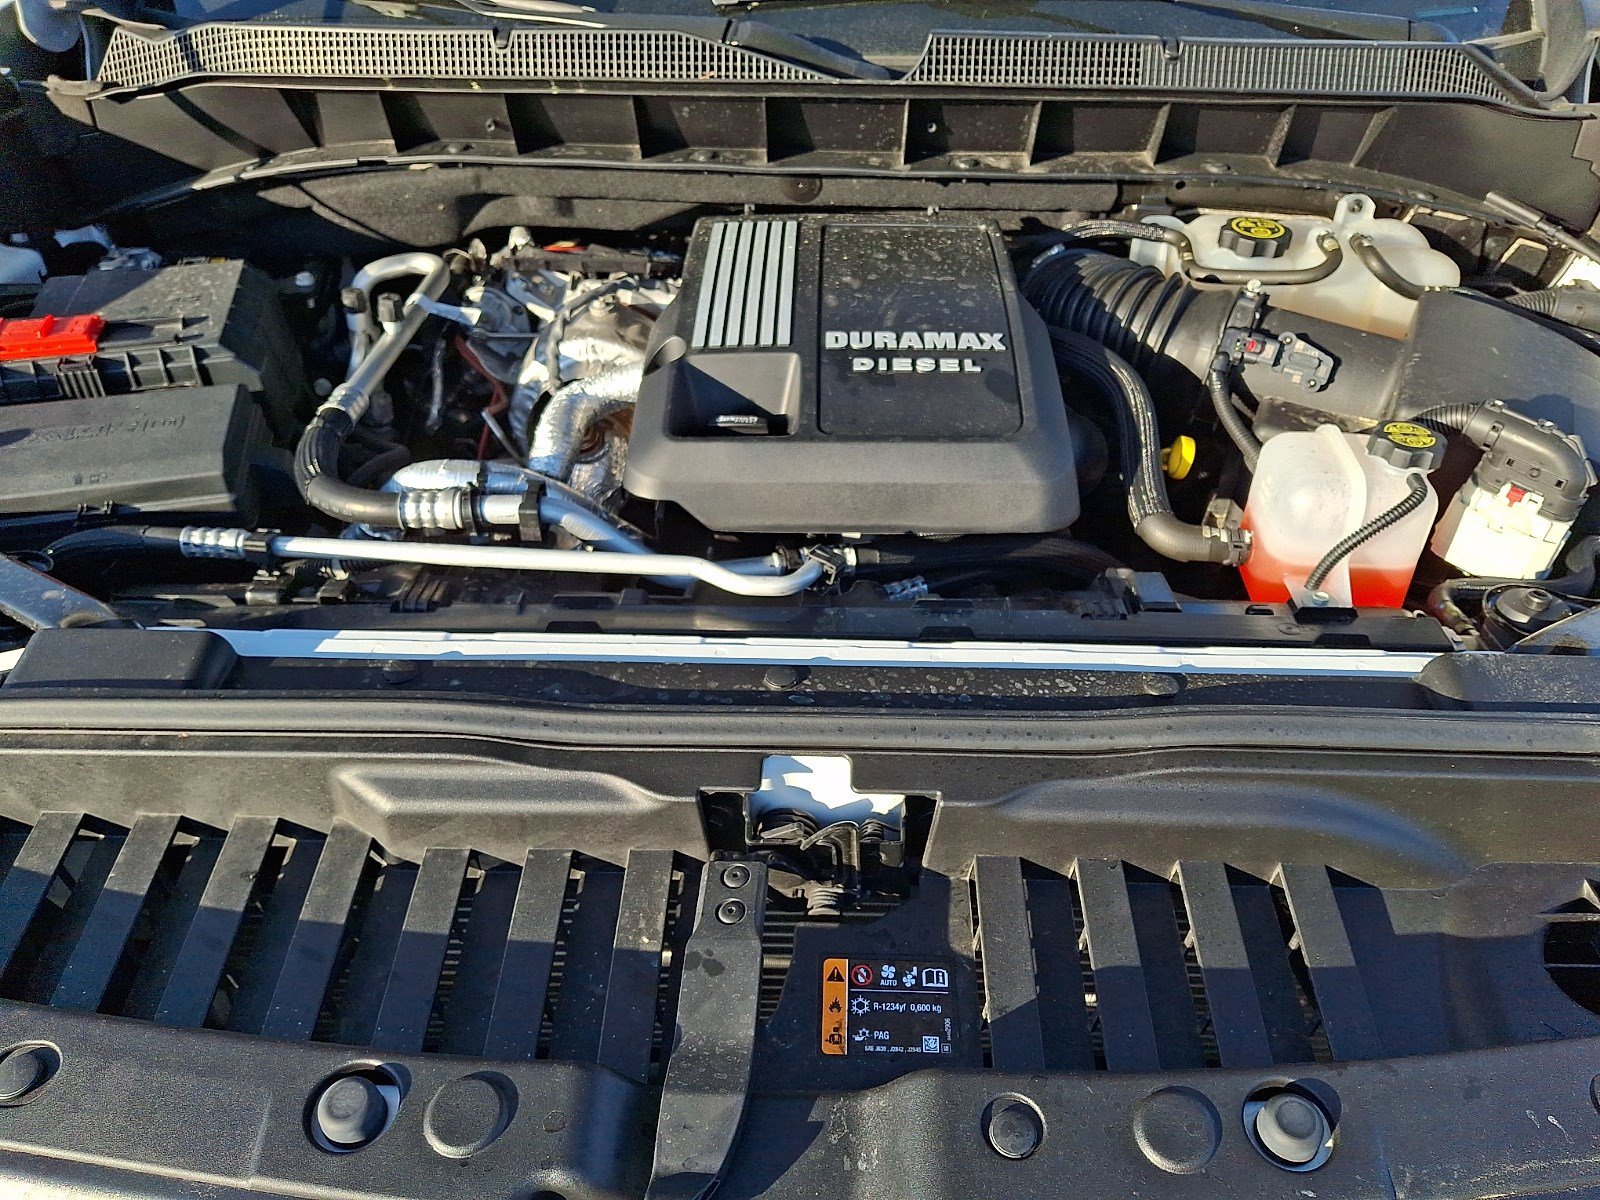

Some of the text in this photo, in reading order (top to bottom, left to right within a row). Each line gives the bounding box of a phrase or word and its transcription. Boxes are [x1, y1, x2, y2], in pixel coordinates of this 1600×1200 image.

[825, 330, 1007, 351] DURAMAX
[852, 357, 982, 373] DIESEL
[880, 979, 897, 987] AUTO
[873, 1002, 906, 1013] R-1234yf
[932, 1004, 942, 1013] kg
[873, 1030, 890, 1040] PAG
